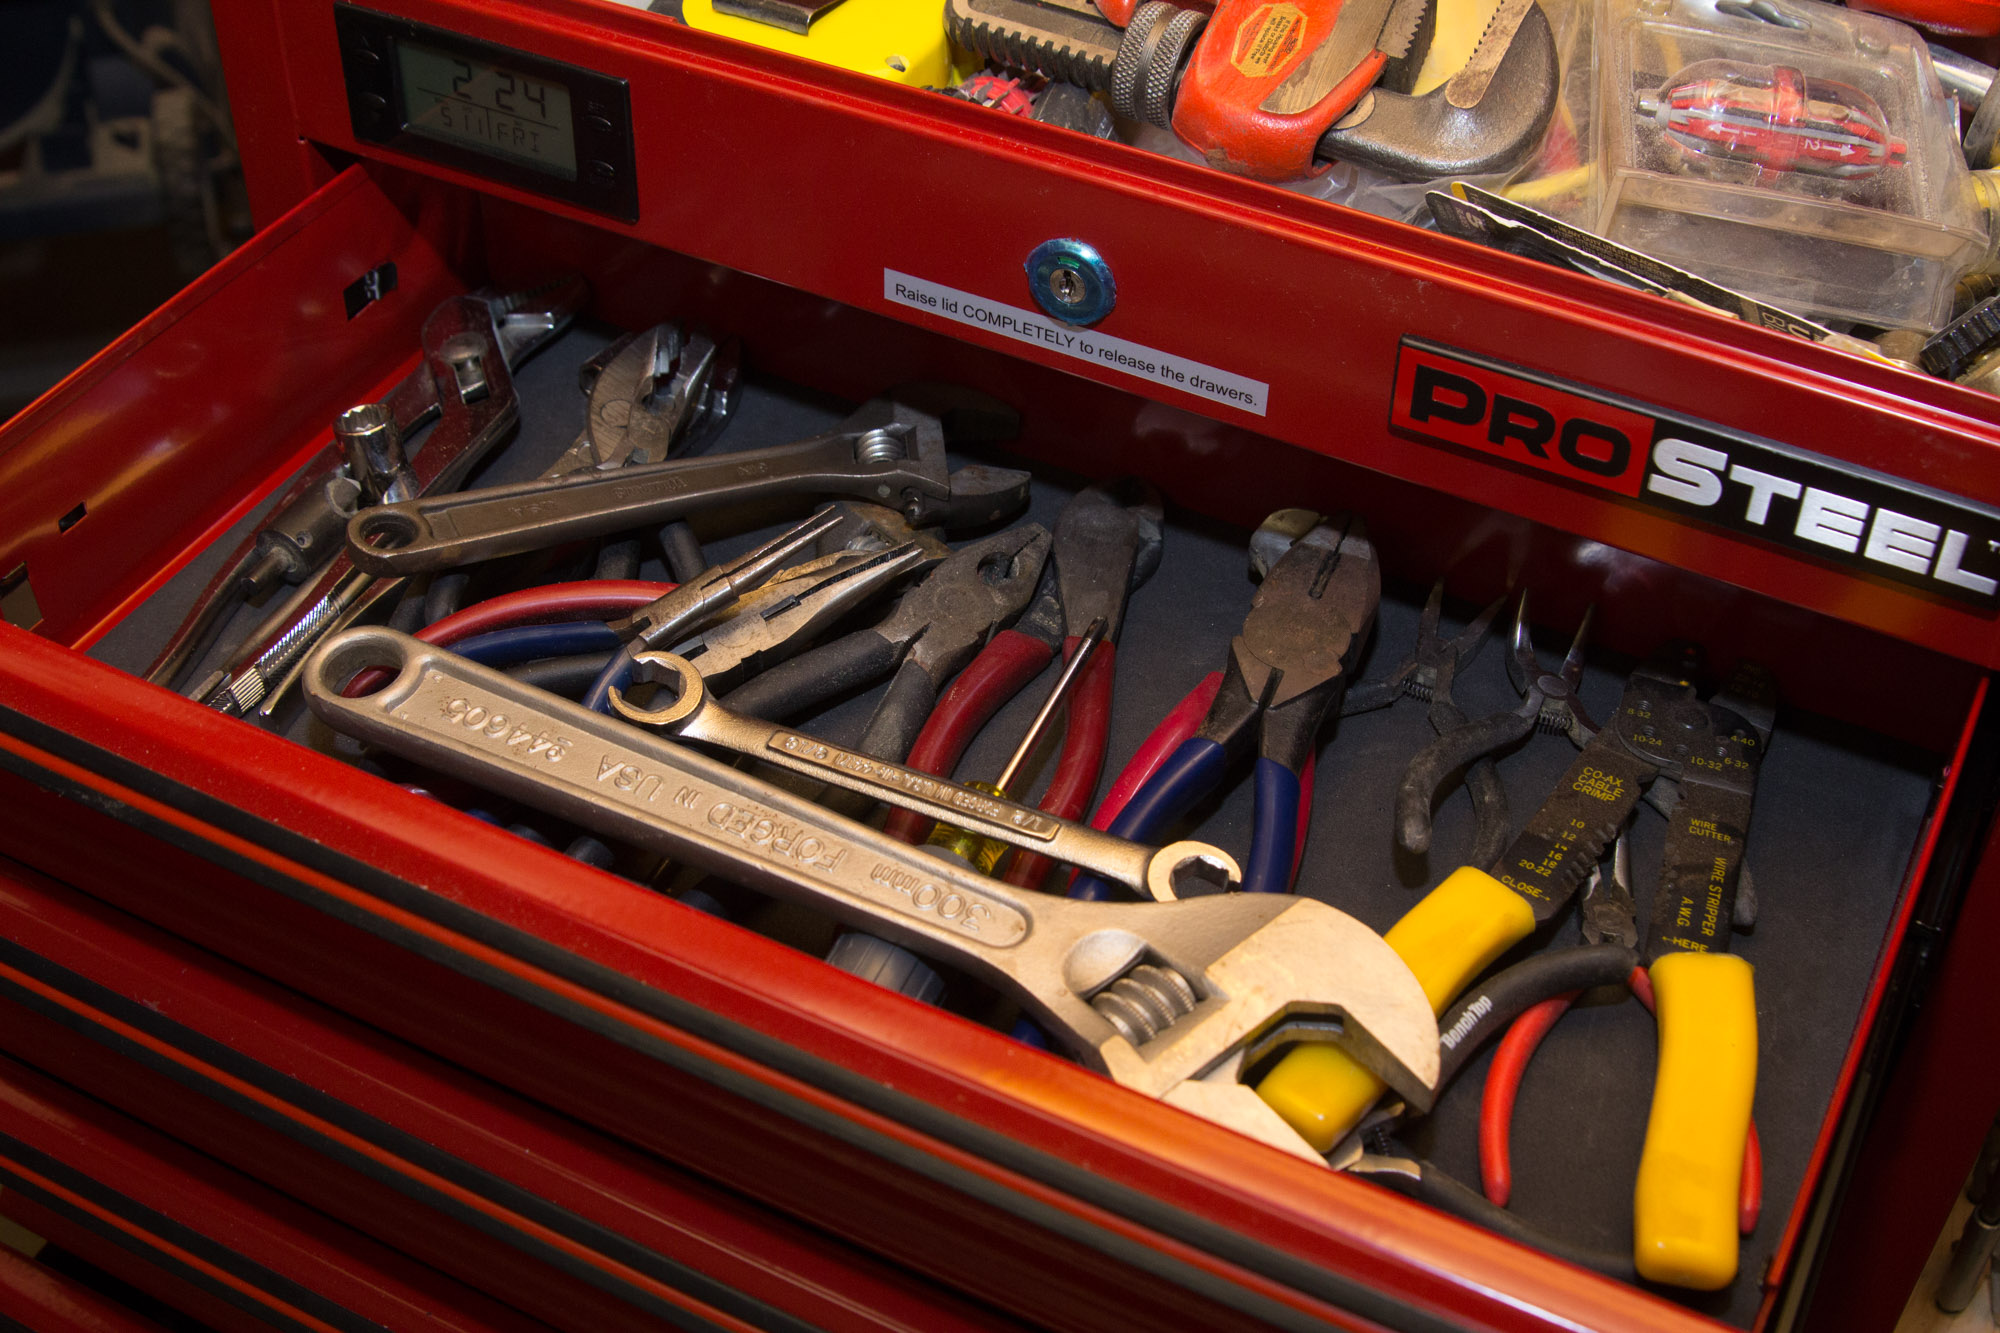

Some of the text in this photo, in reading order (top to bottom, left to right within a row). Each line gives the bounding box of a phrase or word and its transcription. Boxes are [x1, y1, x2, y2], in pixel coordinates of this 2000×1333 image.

[496, 121, 542, 154] FRI
[895, 283, 1258, 406] Raise lid COMPLETELY to release the drawers.
[1647, 437, 1998, 596] STEEL
[1626, 706, 1652, 720] 8-32
[445, 698, 574, 763] 944605
[1633, 733, 1664, 748] 10-24
[1730, 735, 1756, 748] 4-40
[1690, 755, 1723, 772] 10-32
[1724, 756, 1750, 770] 6-32
[596, 754, 666, 803] USA
[1577, 774, 1625, 798] CABLE
[1583, 765, 1625, 788] CO-AX
[1572, 782, 1617, 802] CRIMP
[1570, 818, 1586, 829] 10
[1690, 817, 1717, 831] WIRE
[707, 802, 847, 873] FORGED
[1562, 830, 1577, 842] 12
[1688, 826, 1731, 844] CUTTER
[1541, 856, 1558, 869] 18
[1547, 849, 1564, 862] 16
[1518, 858, 1553, 878] 20-22
[1501, 874, 1543, 899] CLOSE
[871, 862, 991, 932] 300mm
[1700, 857, 1728, 937] WIRE STRIPPER
[1673, 936, 1709, 953] HERE
